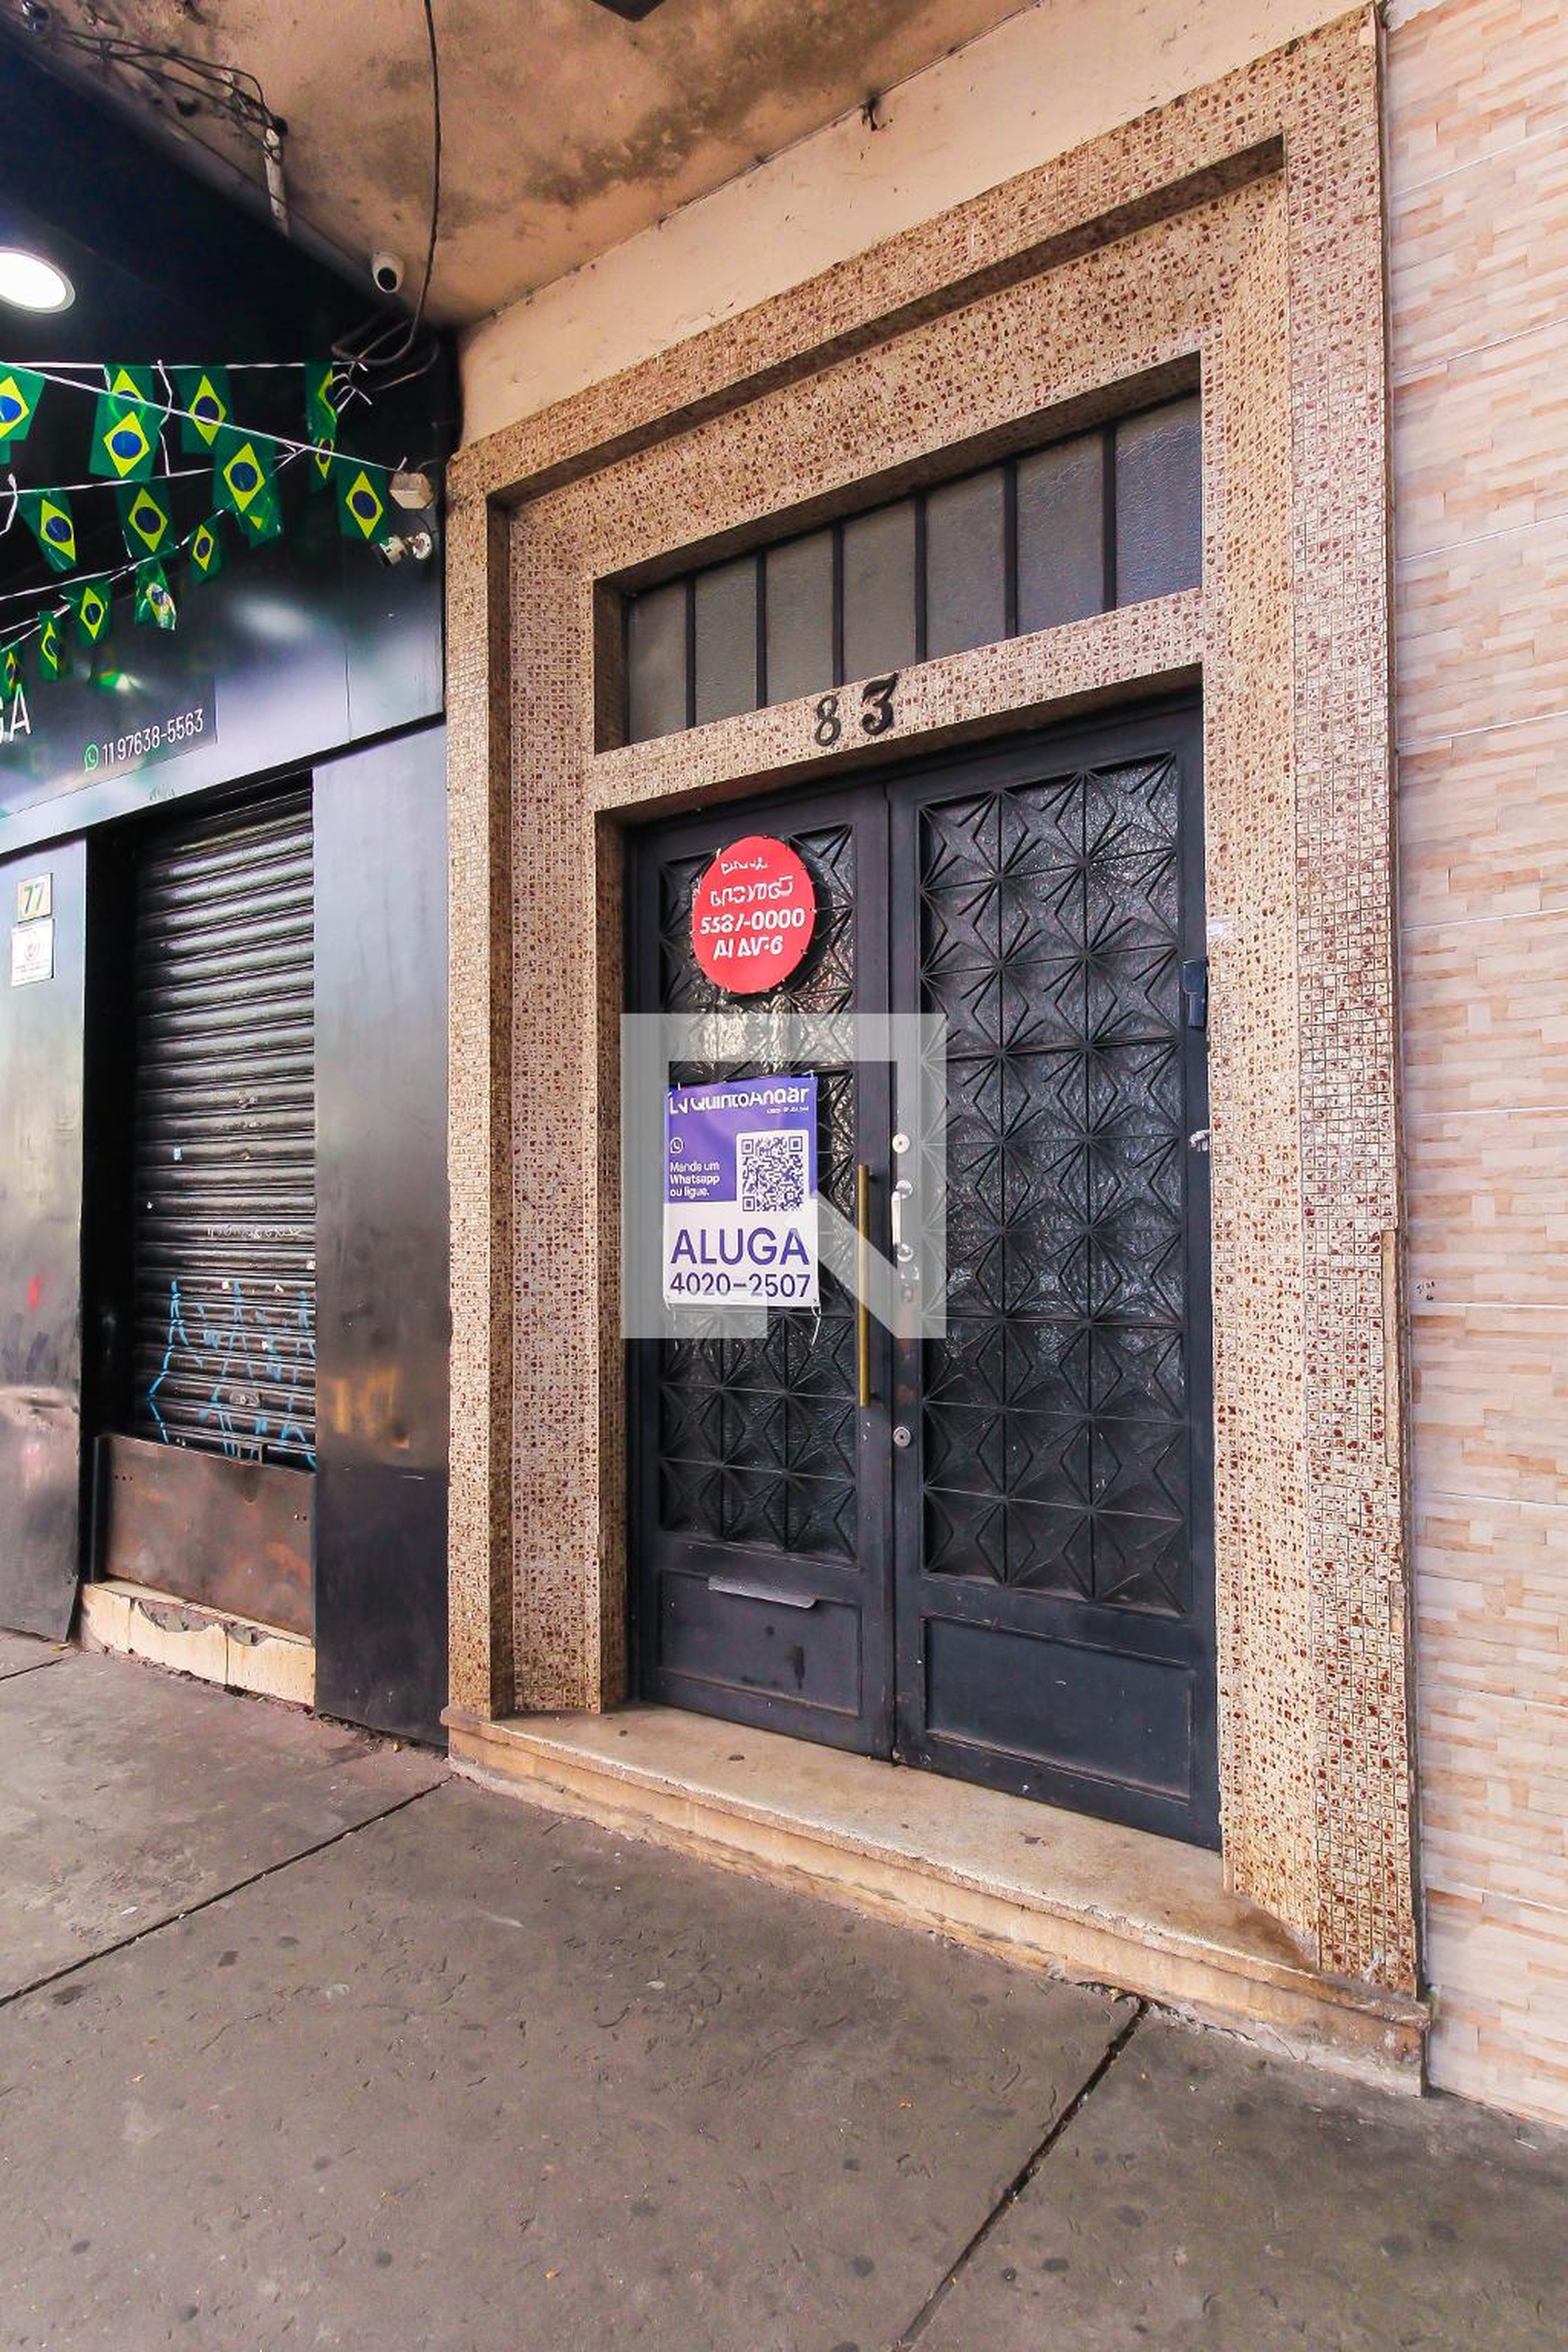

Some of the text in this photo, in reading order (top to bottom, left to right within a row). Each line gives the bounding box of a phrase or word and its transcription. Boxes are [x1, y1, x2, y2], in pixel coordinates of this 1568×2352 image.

[815, 672, 898, 746] 83
[102, 708, 203, 766] 11 97638-5563
[670, 1227, 809, 1265] ALUGA
[670, 1272, 811, 1297] 4020-2507
